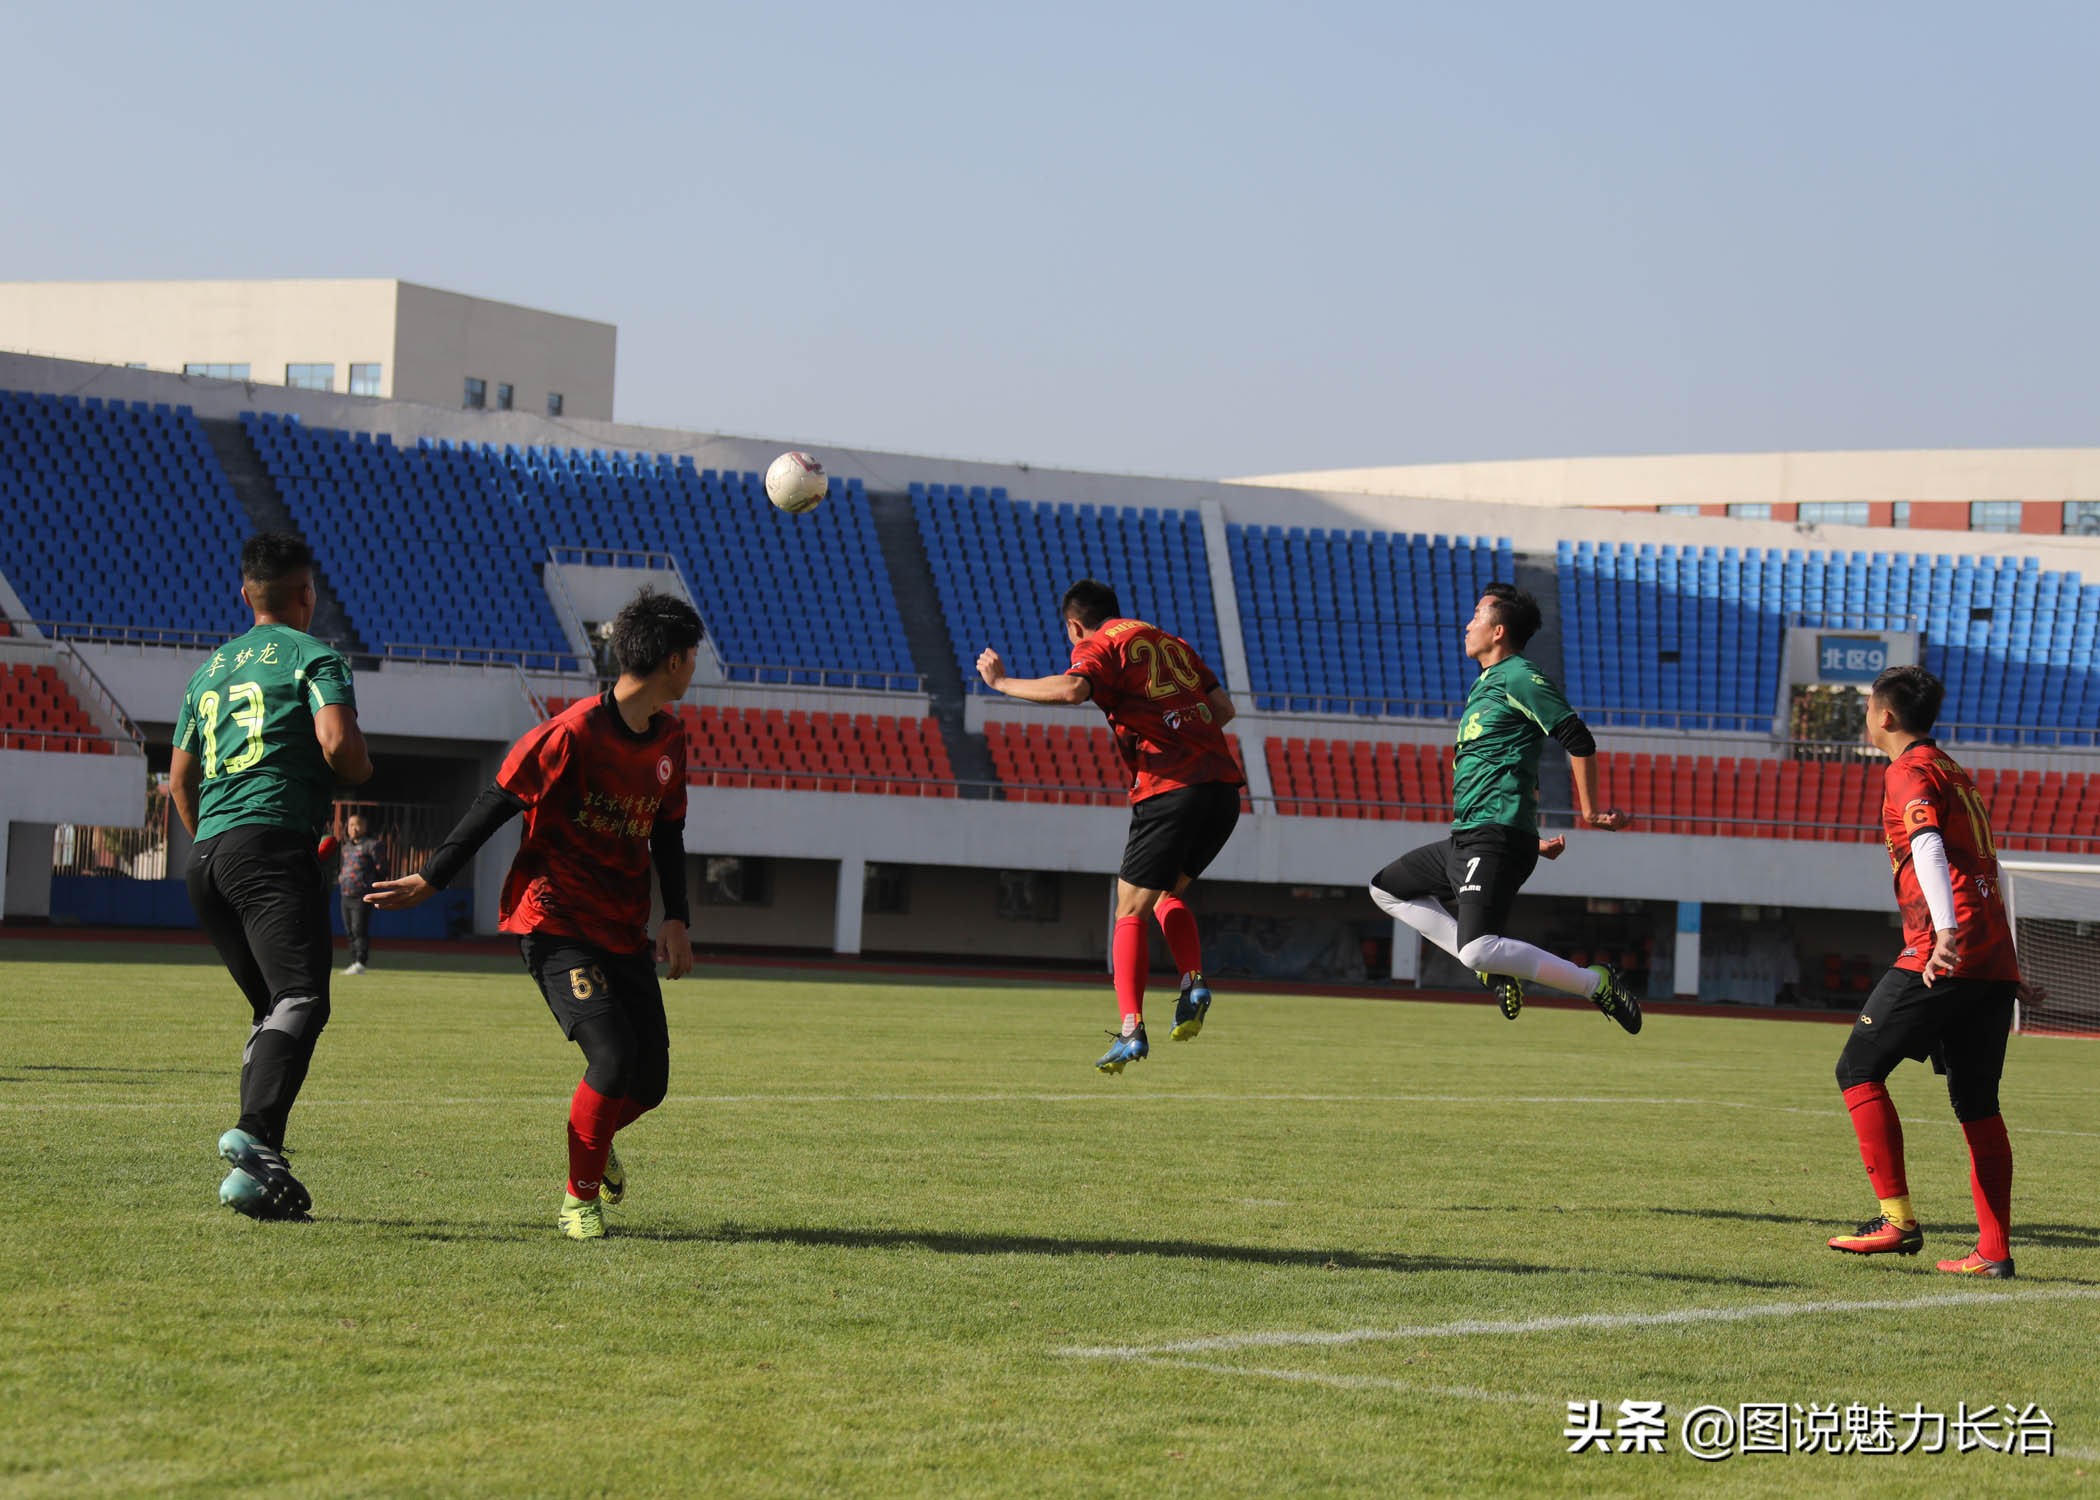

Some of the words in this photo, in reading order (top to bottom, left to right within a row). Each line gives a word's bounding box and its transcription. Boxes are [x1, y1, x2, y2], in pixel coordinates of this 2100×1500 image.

[205, 642, 279, 678] 李梦龙
[1128, 635, 1200, 700] 20
[1822, 647, 1885, 672] 北区9
[199, 681, 265, 779] 13
[1911, 808, 1928, 825] C
[1464, 857, 1481, 883] 7
